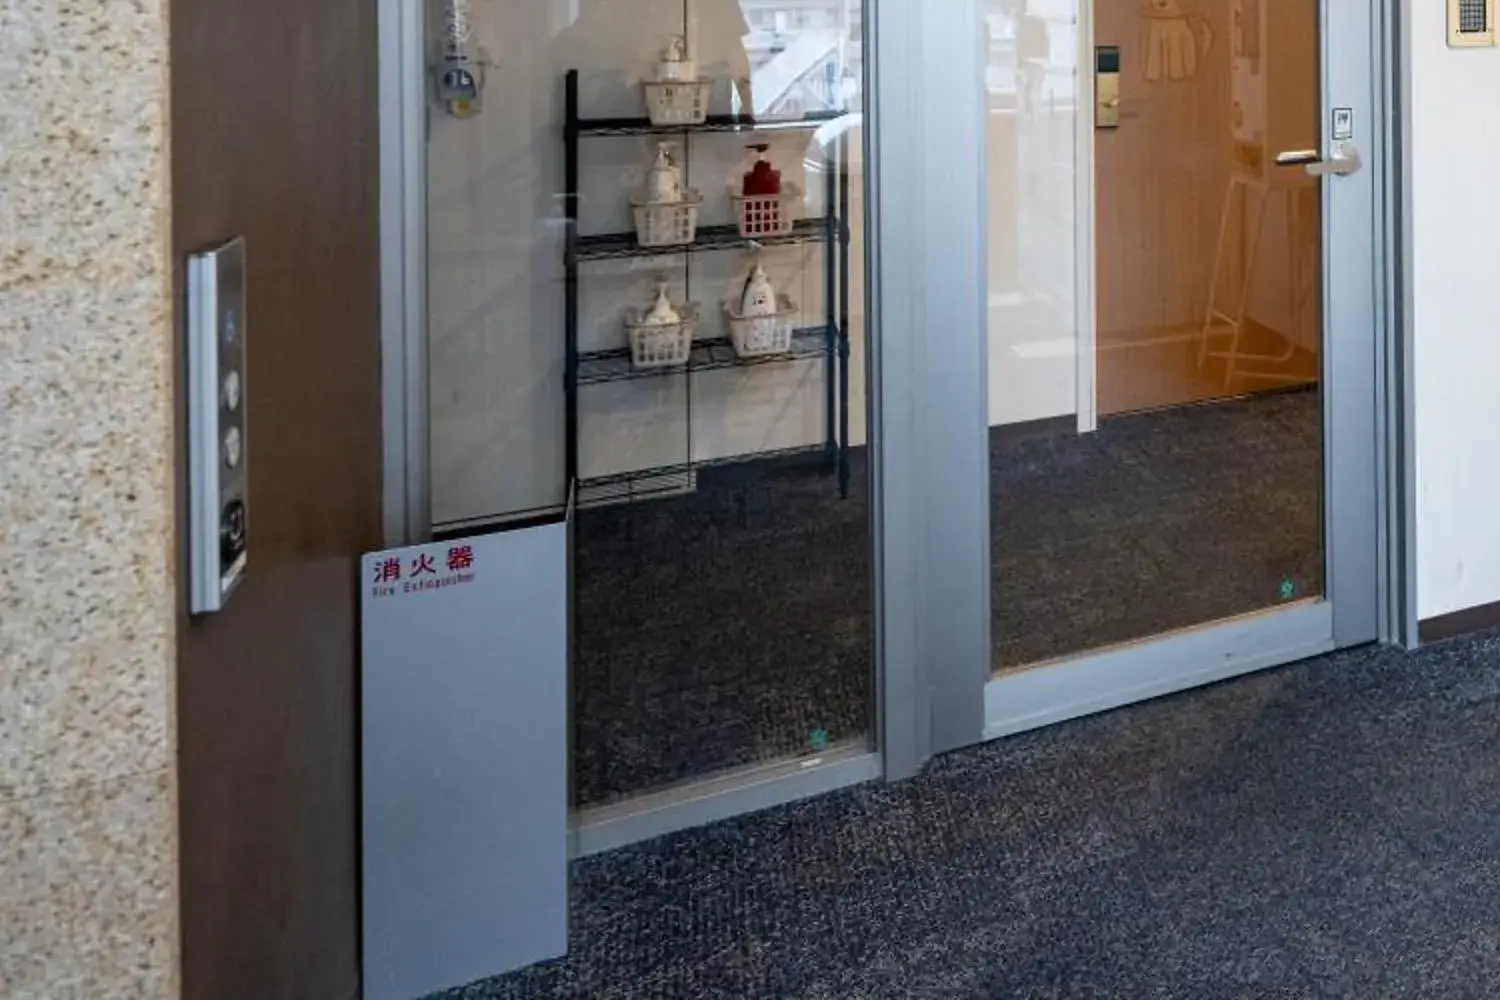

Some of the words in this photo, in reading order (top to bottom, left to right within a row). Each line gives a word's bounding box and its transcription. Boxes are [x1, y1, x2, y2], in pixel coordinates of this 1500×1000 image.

[373, 545, 475, 583] 消火器
[372, 587, 395, 599] Fire
